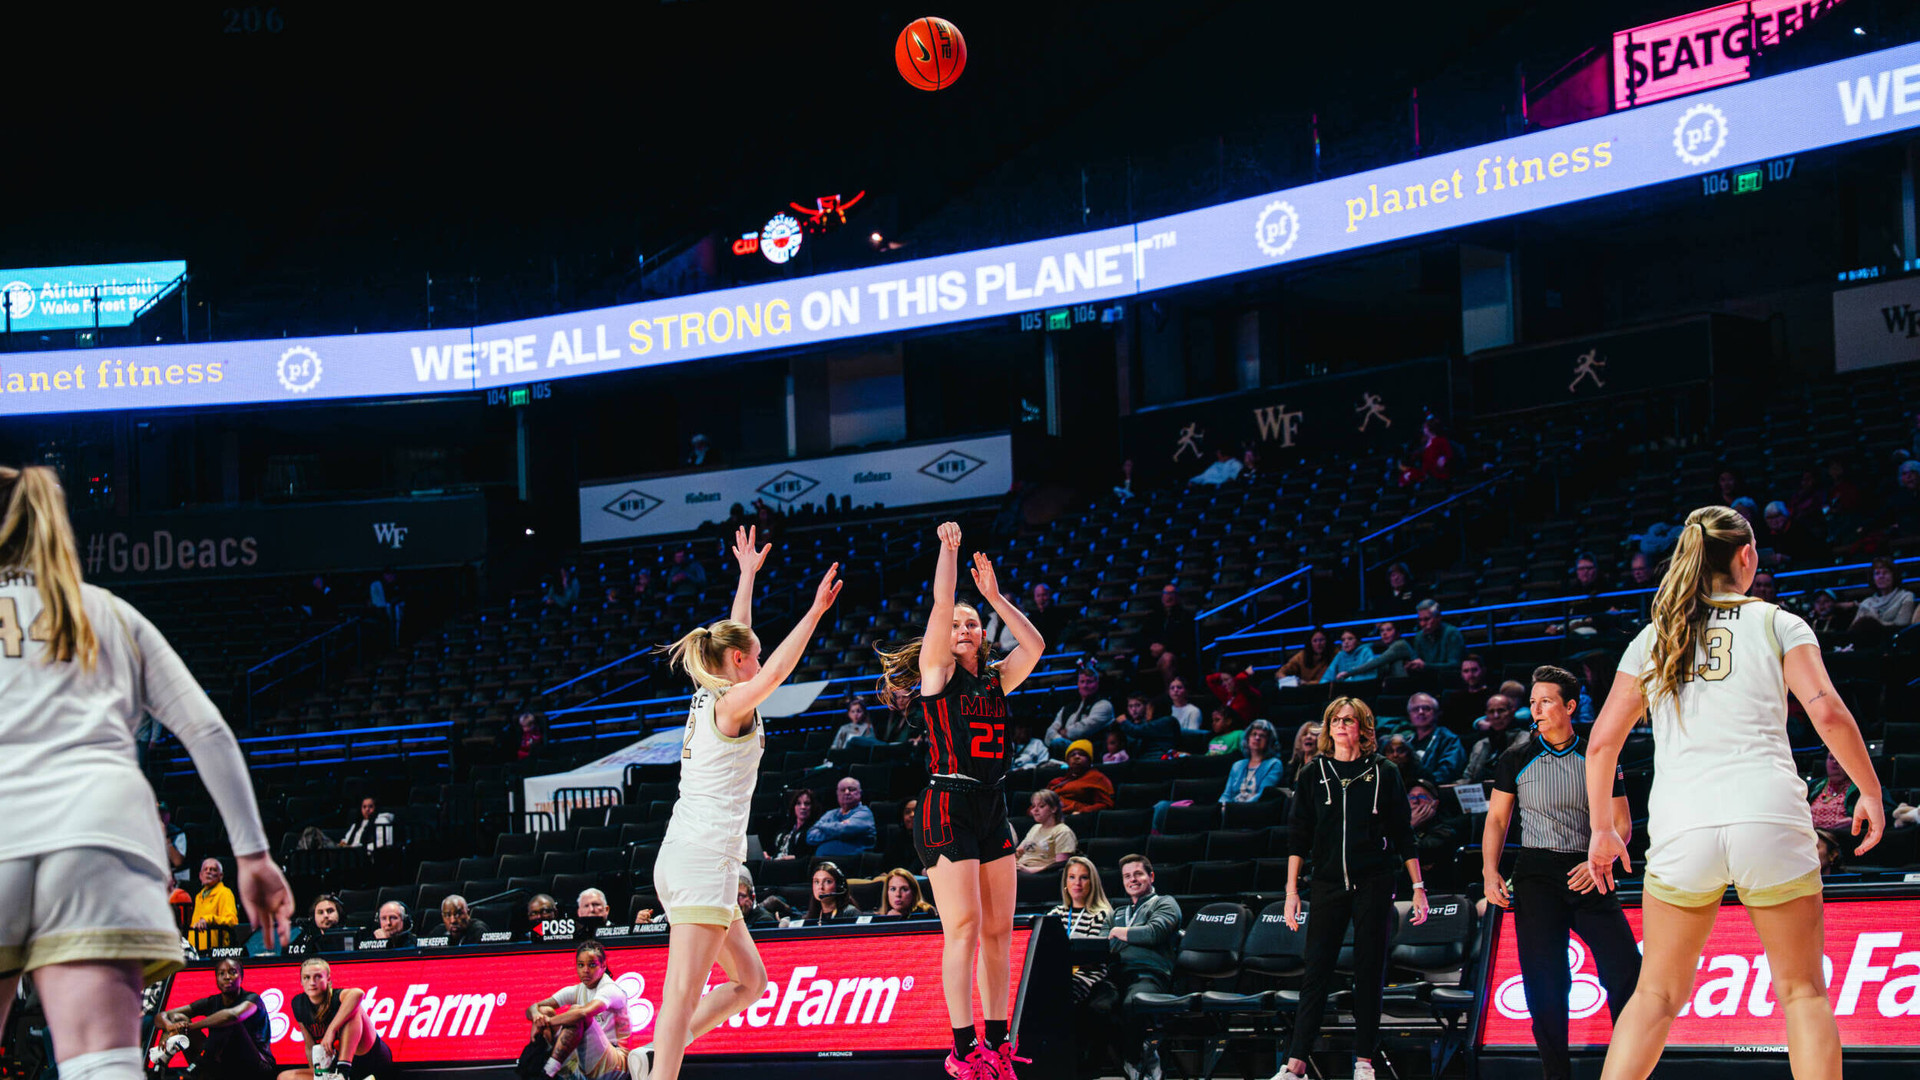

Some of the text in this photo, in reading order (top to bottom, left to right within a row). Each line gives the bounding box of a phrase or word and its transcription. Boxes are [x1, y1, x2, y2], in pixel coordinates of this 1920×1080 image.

[221, 6, 286, 34] 206
[1345, 168, 1463, 232] planet
[1475, 140, 1613, 194] fitness
[1702, 172, 1729, 195] 106
[1768, 157, 1796, 181] 107
[40, 299, 79, 314] Wake
[1021, 312, 1042, 331] 105
[1074, 305, 1096, 323] 106
[411, 334, 538, 382] WE'RE
[546, 324, 621, 369] ALL
[629, 299, 792, 355] STRONG
[801, 286, 860, 331] ON
[868, 270, 968, 321] THIS
[98, 359, 224, 388] fitness
[487, 389, 507, 406] 104
[532, 383, 552, 400] 105
[1254, 405, 1303, 448] WF
[937, 459, 966, 474] WFWS
[774, 480, 802, 493] WFWS
[619, 499, 646, 511] WFWS
[373, 521, 409, 549] WF
[85, 530, 258, 574] #GoDeacs
[969, 721, 1005, 759] 23
[541, 918, 576, 935] POSS
[1196, 913, 1224, 924] TRUIST
[1261, 914, 1287, 923] TRUIS
[212, 947, 243, 958] DVSPORT
